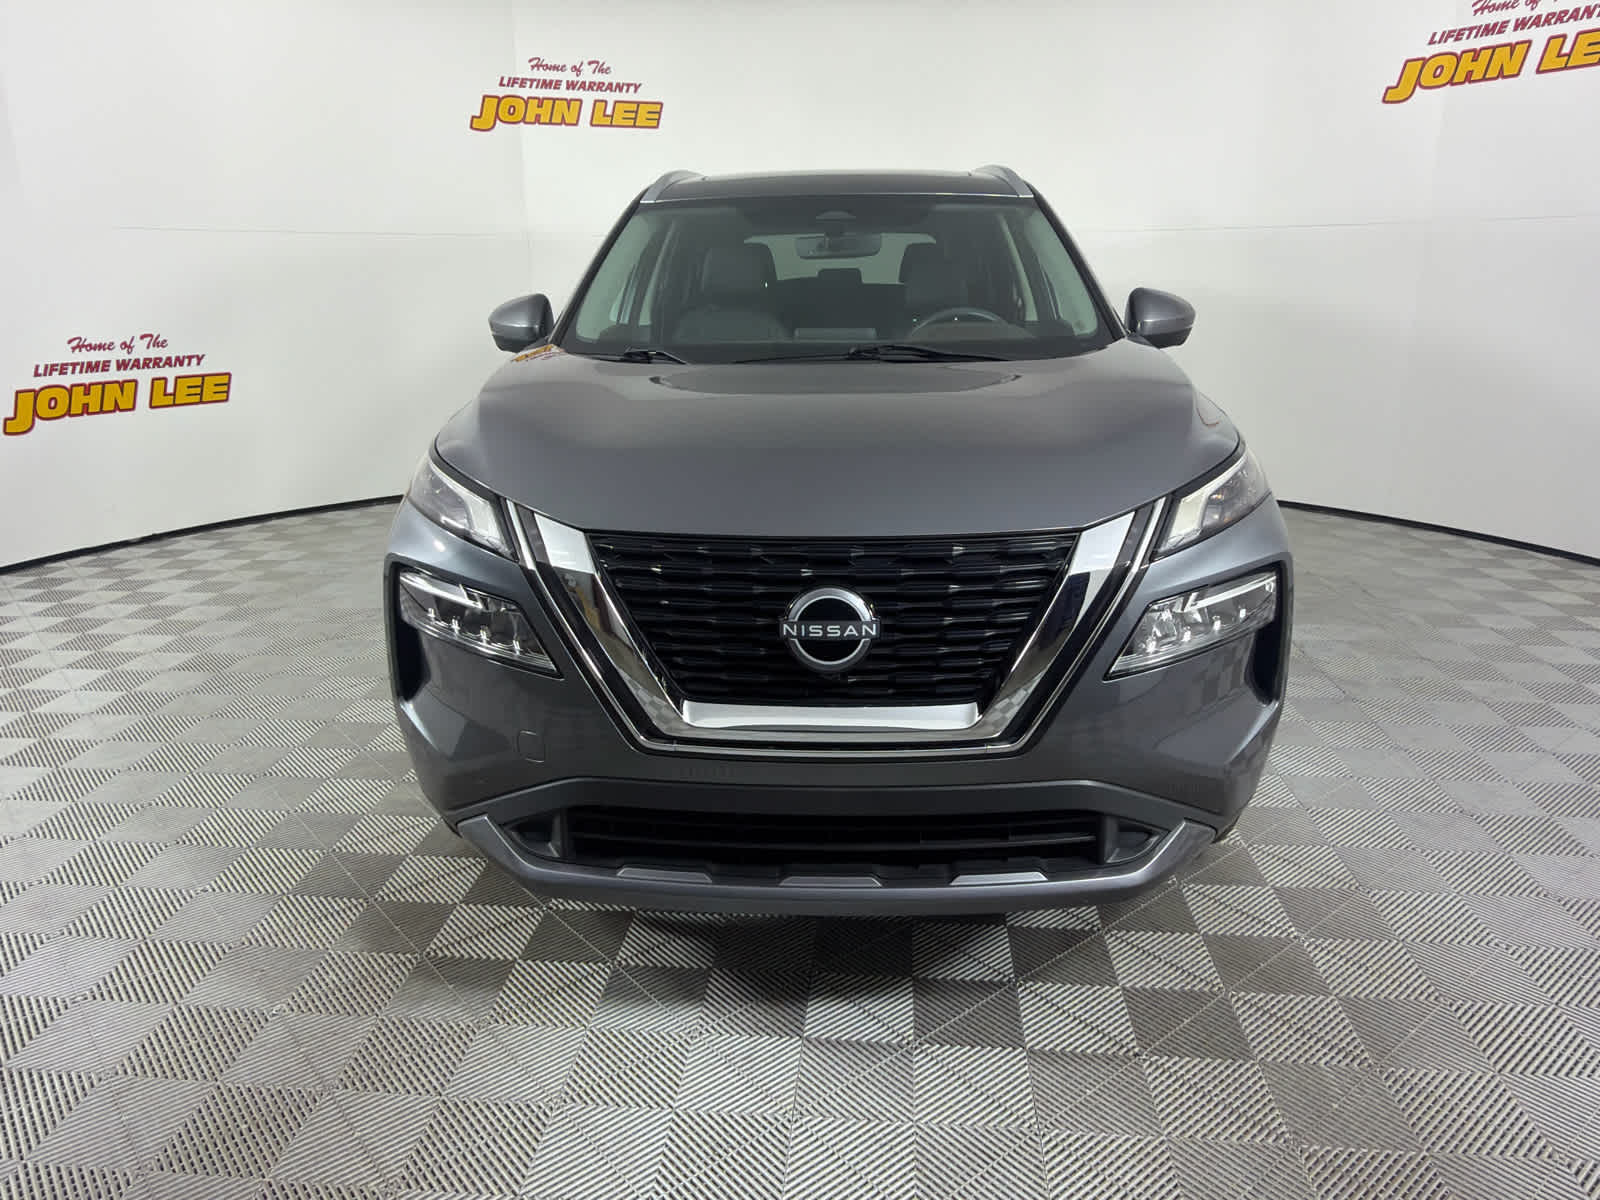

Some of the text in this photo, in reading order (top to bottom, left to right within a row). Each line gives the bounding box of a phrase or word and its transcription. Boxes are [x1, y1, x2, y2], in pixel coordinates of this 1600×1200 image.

[1472, 0, 1520, 16] Home
[1427, 20, 1511, 45] LIFETIME
[528, 56, 613, 77] Home of The
[1382, 39, 1532, 104] JOHN
[498, 76, 642, 94] LIFETIME WARRANTY
[470, 94, 664, 132] JOHN LEE
[67, 333, 169, 354] Home of The
[33, 353, 206, 378] LIFETIME WARRANTY
[3, 372, 232, 436] JOHN LEE
[782, 623, 877, 637] NISSAN
